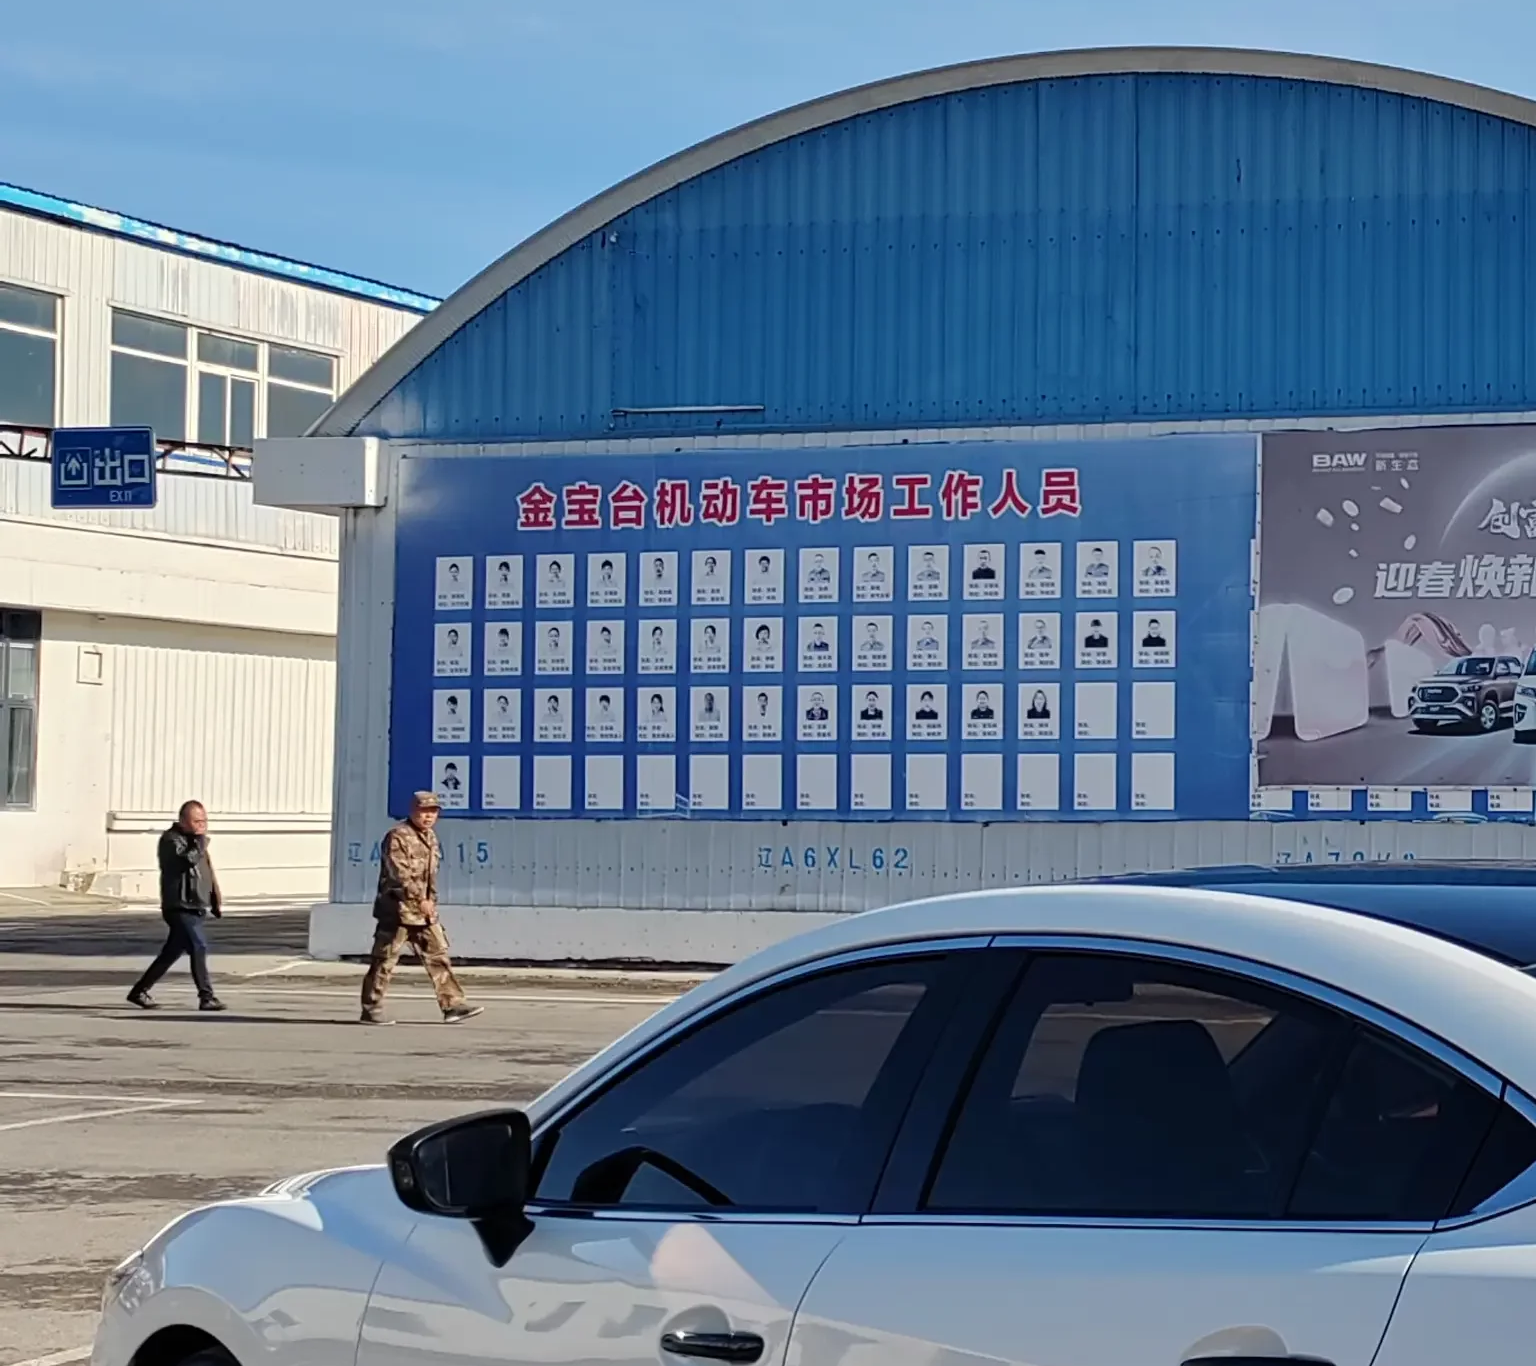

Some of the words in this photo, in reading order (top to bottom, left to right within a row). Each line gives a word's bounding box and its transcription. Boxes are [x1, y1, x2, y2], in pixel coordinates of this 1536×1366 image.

[93, 448, 150, 486] 出口
[1312, 453, 1367, 467] BAW
[516, 468, 1082, 531] 金宝台机动车市场工作人员
[758, 846, 909, 870] 辽A6XL62
